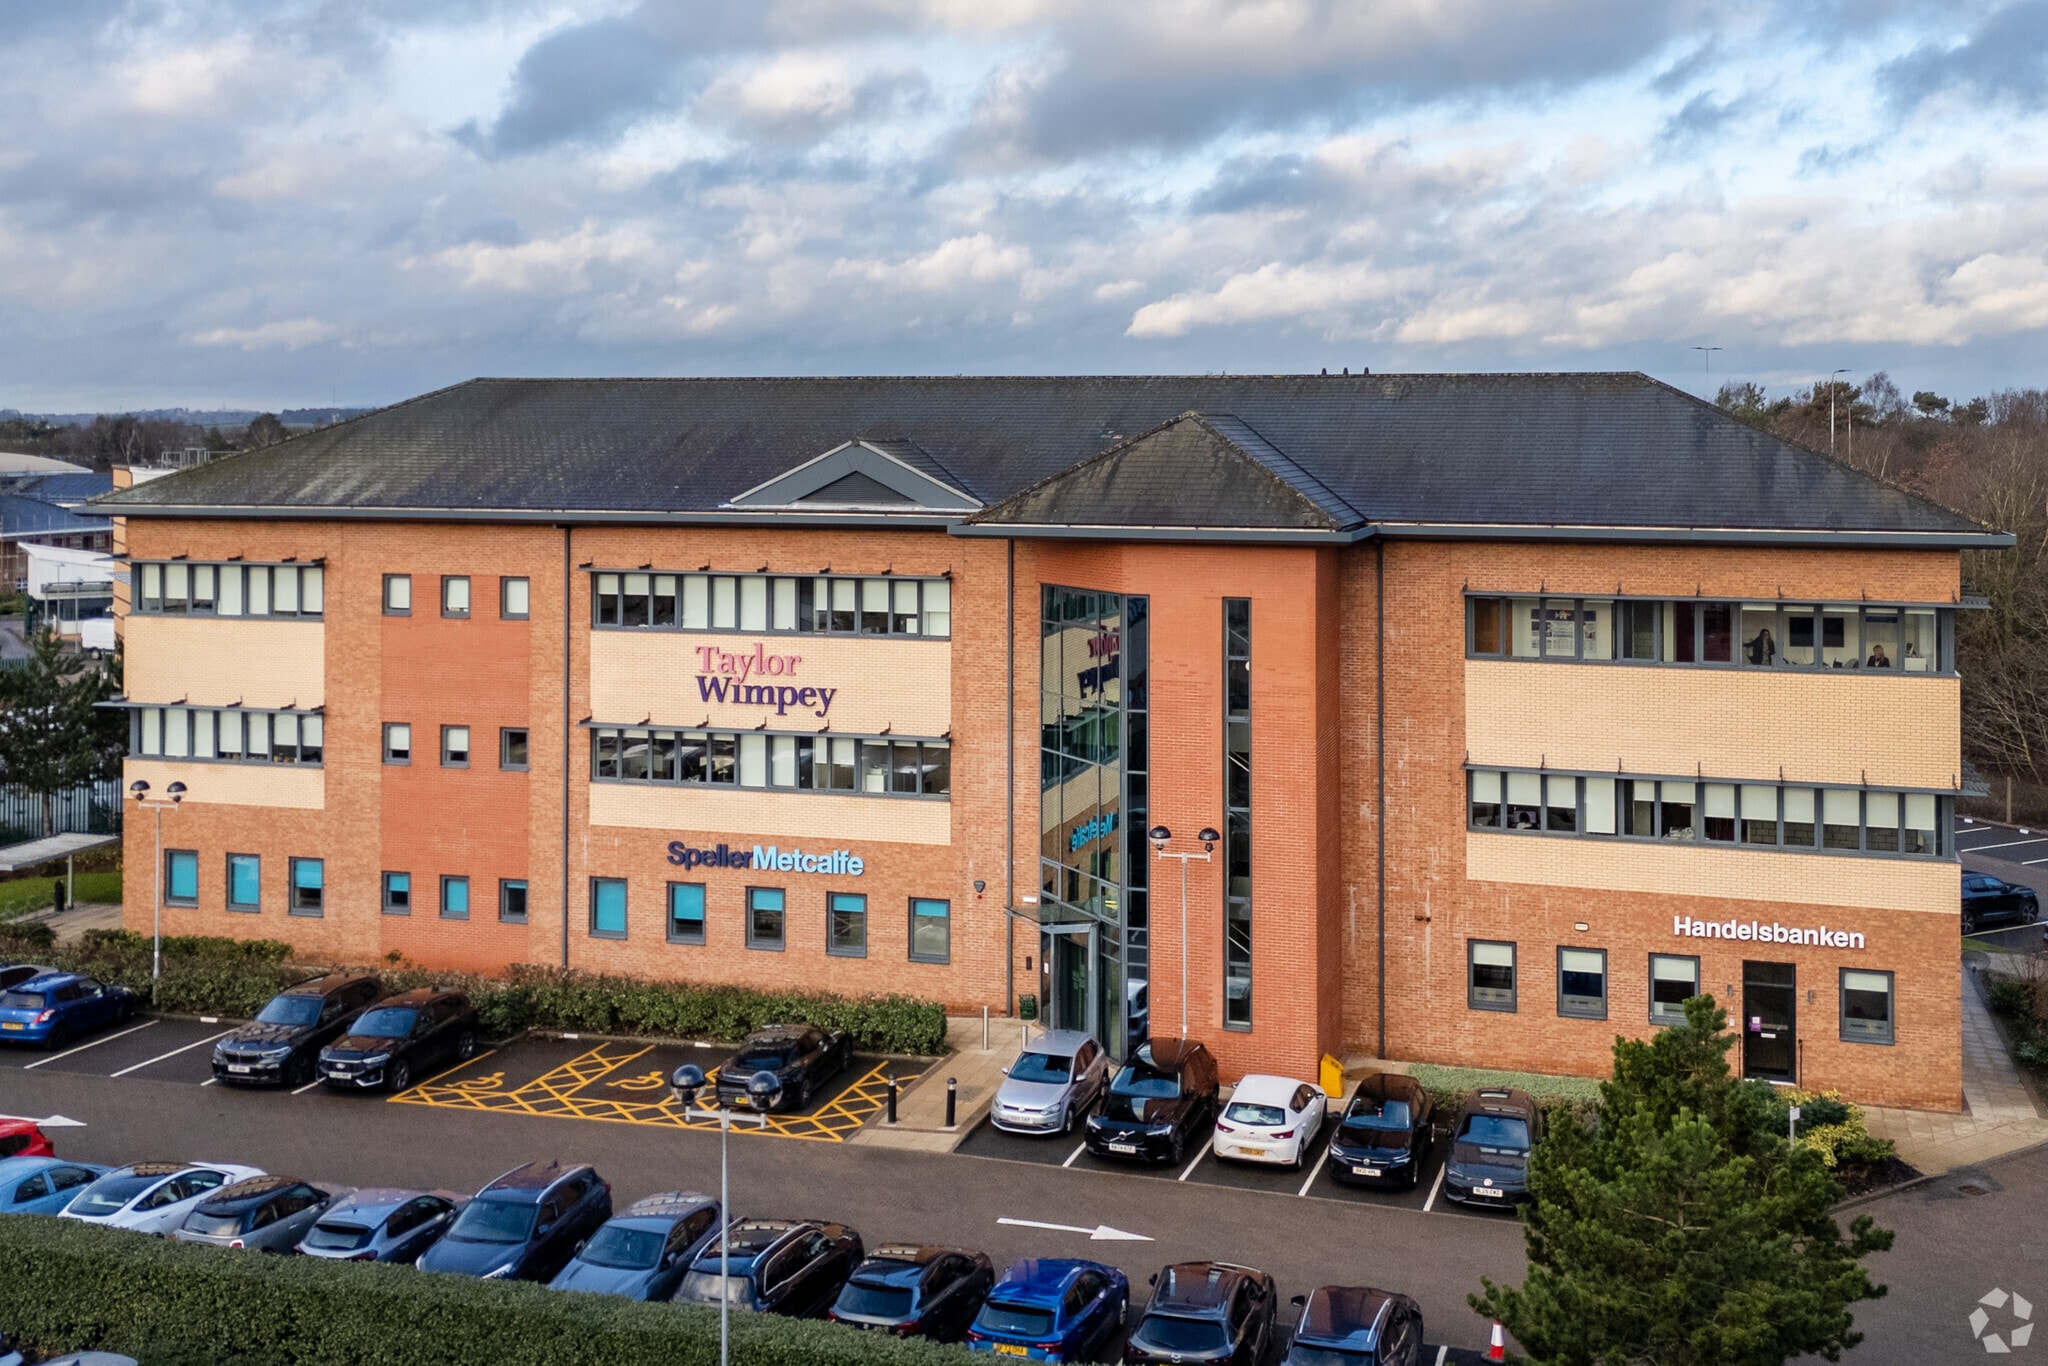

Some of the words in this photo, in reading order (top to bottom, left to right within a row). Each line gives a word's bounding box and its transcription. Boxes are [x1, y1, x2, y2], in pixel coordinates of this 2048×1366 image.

[694, 643, 802, 684] Taylor
[695, 675, 837, 718] Wimpey
[1673, 915, 1865, 949] Handelsbanken
